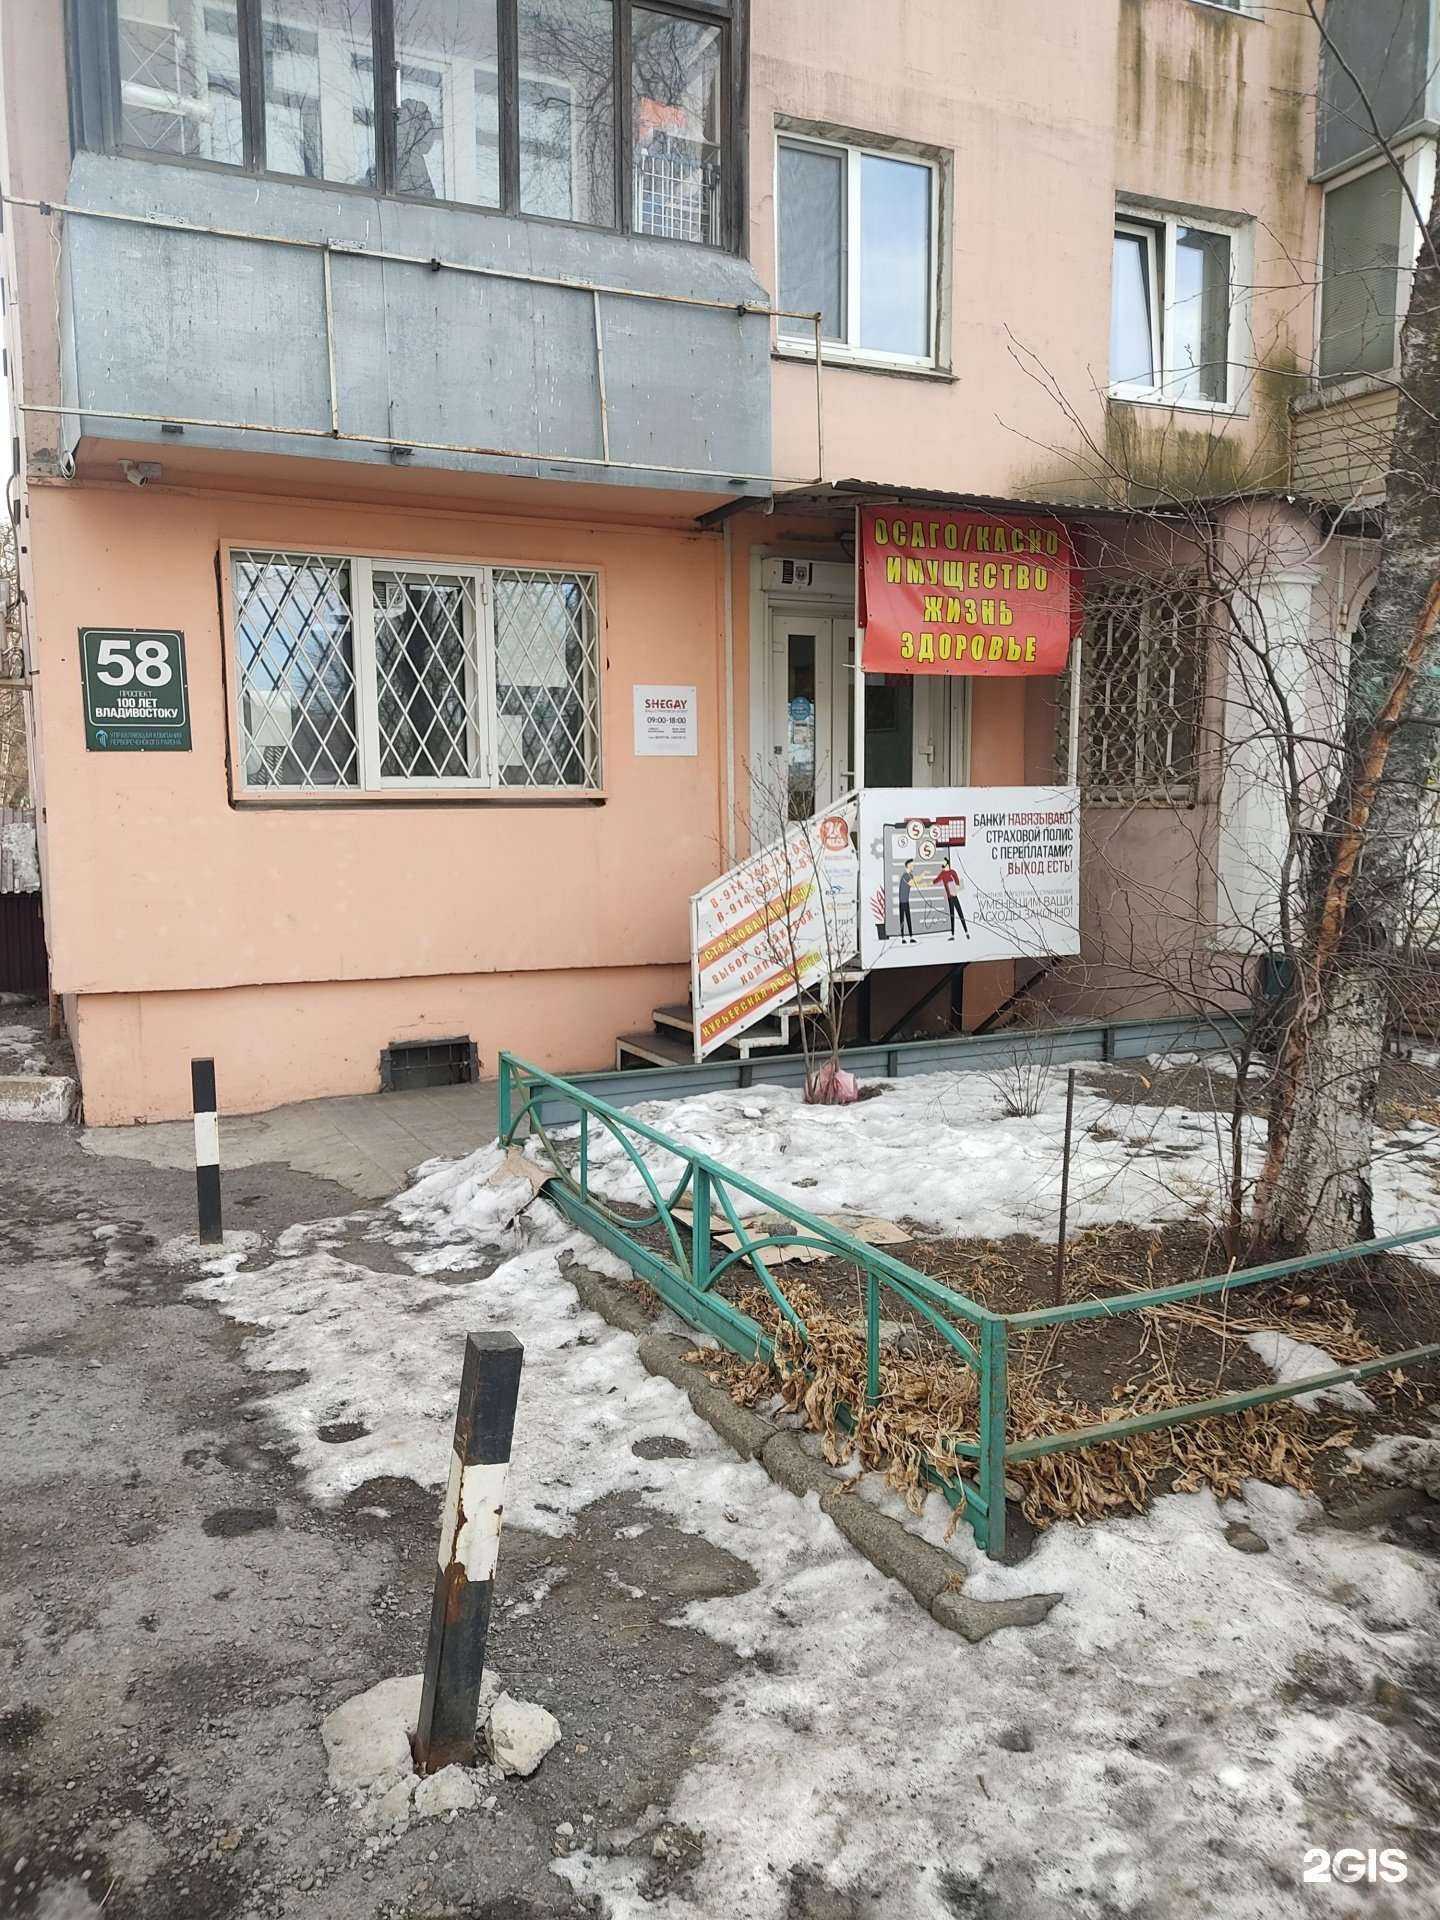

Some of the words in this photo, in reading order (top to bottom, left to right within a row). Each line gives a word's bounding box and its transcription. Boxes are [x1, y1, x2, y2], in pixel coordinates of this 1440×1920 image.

[874, 517, 1060, 556] ОСАГО/КАСКО
[886, 555, 1049, 593] ИМУЩЕСТВО
[922, 595, 1014, 627] ЖИЗНЬ
[900, 631, 1038, 664] ЗДОРОВЬЕ
[96, 639, 173, 687] 58
[119, 690, 152, 698] ПРОСПЕКТ
[116, 698, 136, 708] 100
[138, 698, 158, 708] ЛЕТ
[644, 698, 688, 710] SHEGAY
[95, 707, 179, 719] ВЛАДИВОСТОКУ
[973, 813, 1006, 827] БАНКИ
[1008, 811, 1073, 826] НАВЯЗЫВАЮТ
[986, 827, 1041, 843] СТРАХОВОЙ
[1042, 826, 1074, 841] ПОЛИС
[991, 847, 998, 860] С
[1000, 844, 1074, 860] ПЕРЕПЛАТАМИ?
[1007, 862, 1045, 875] ВЫХОД
[1047, 860, 1073, 873] ЕСТЬ!
[1043, 896, 1073, 907] ВАШИ
[973, 911, 1023, 922] РАСХОДЫ
